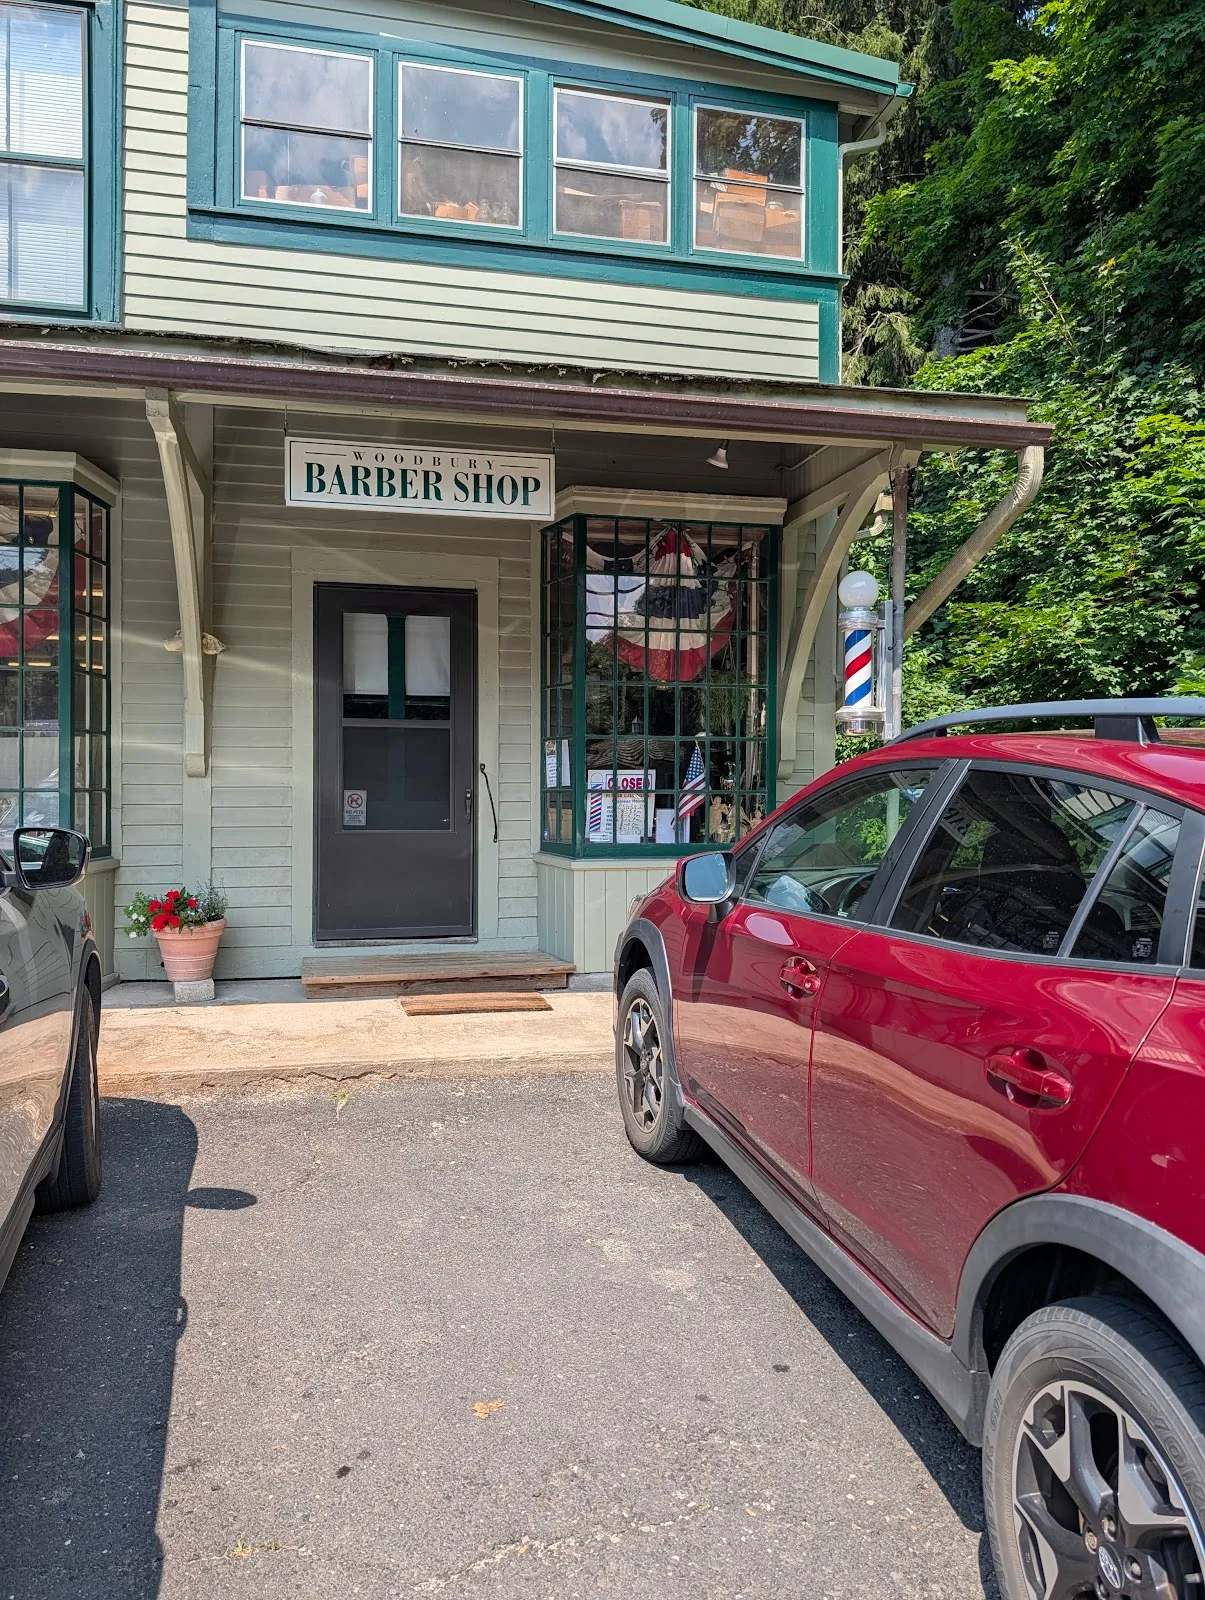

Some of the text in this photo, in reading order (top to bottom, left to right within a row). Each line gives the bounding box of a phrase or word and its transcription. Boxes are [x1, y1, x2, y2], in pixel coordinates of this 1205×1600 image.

[352, 451, 496, 470] WOODBURY
[304, 462, 541, 506] BARBER SHOP
[607, 777, 651, 790] COSE
